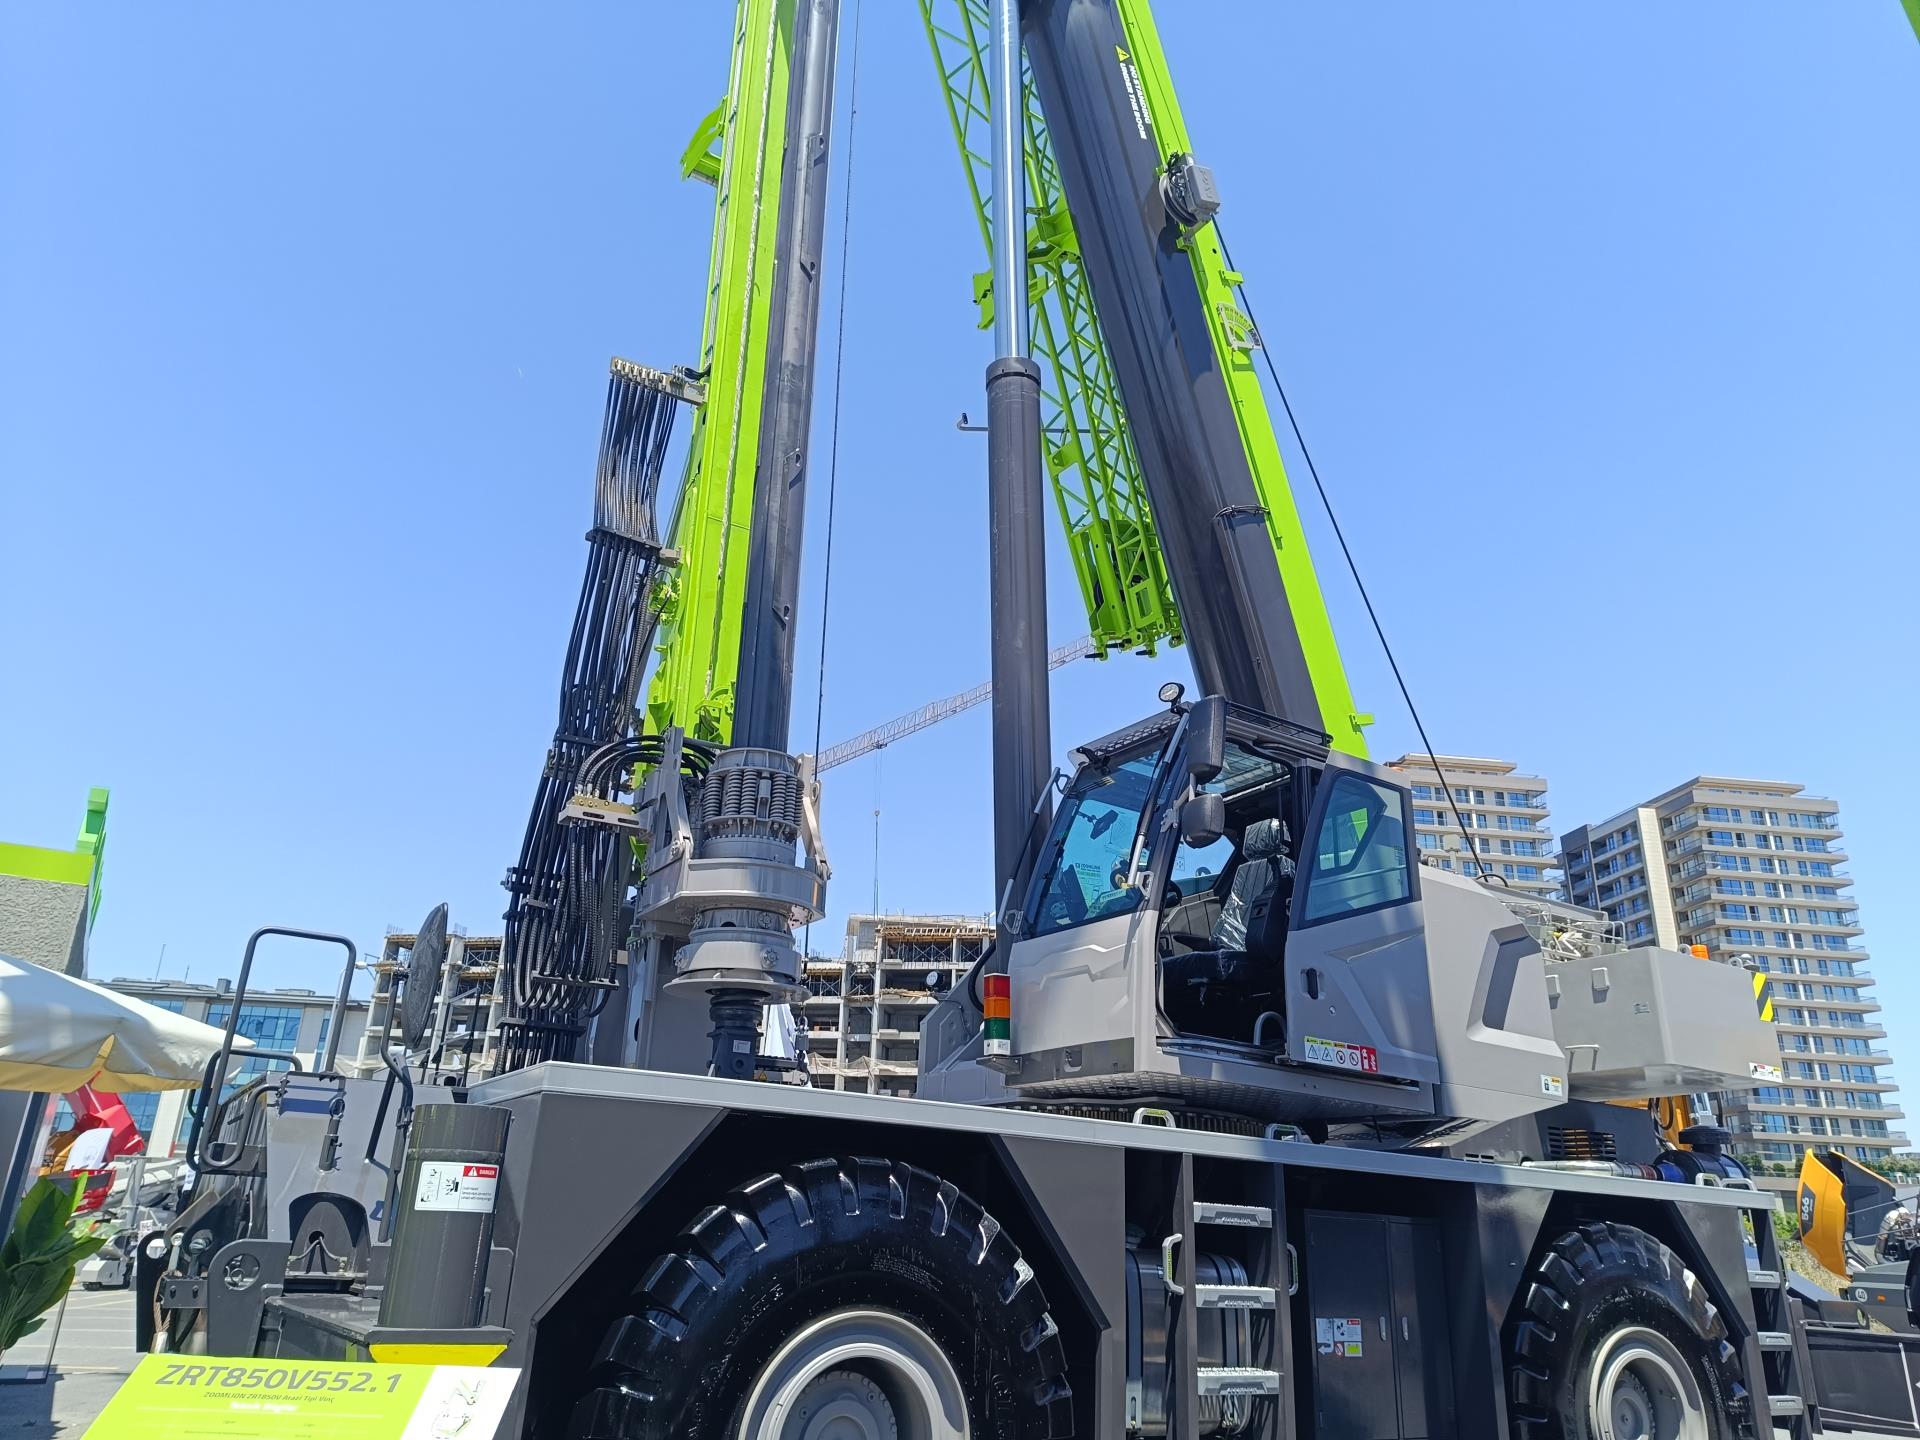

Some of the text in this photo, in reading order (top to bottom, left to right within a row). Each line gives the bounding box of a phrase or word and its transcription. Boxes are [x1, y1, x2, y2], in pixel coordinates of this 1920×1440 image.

[1120, 62, 1148, 140] UNDER THE BOOM
[1128, 64, 1152, 125] NO STANDING
[155, 1363, 403, 1394] ZRT850V552.1
[203, 1391, 246, 1399] ZOOMLION
